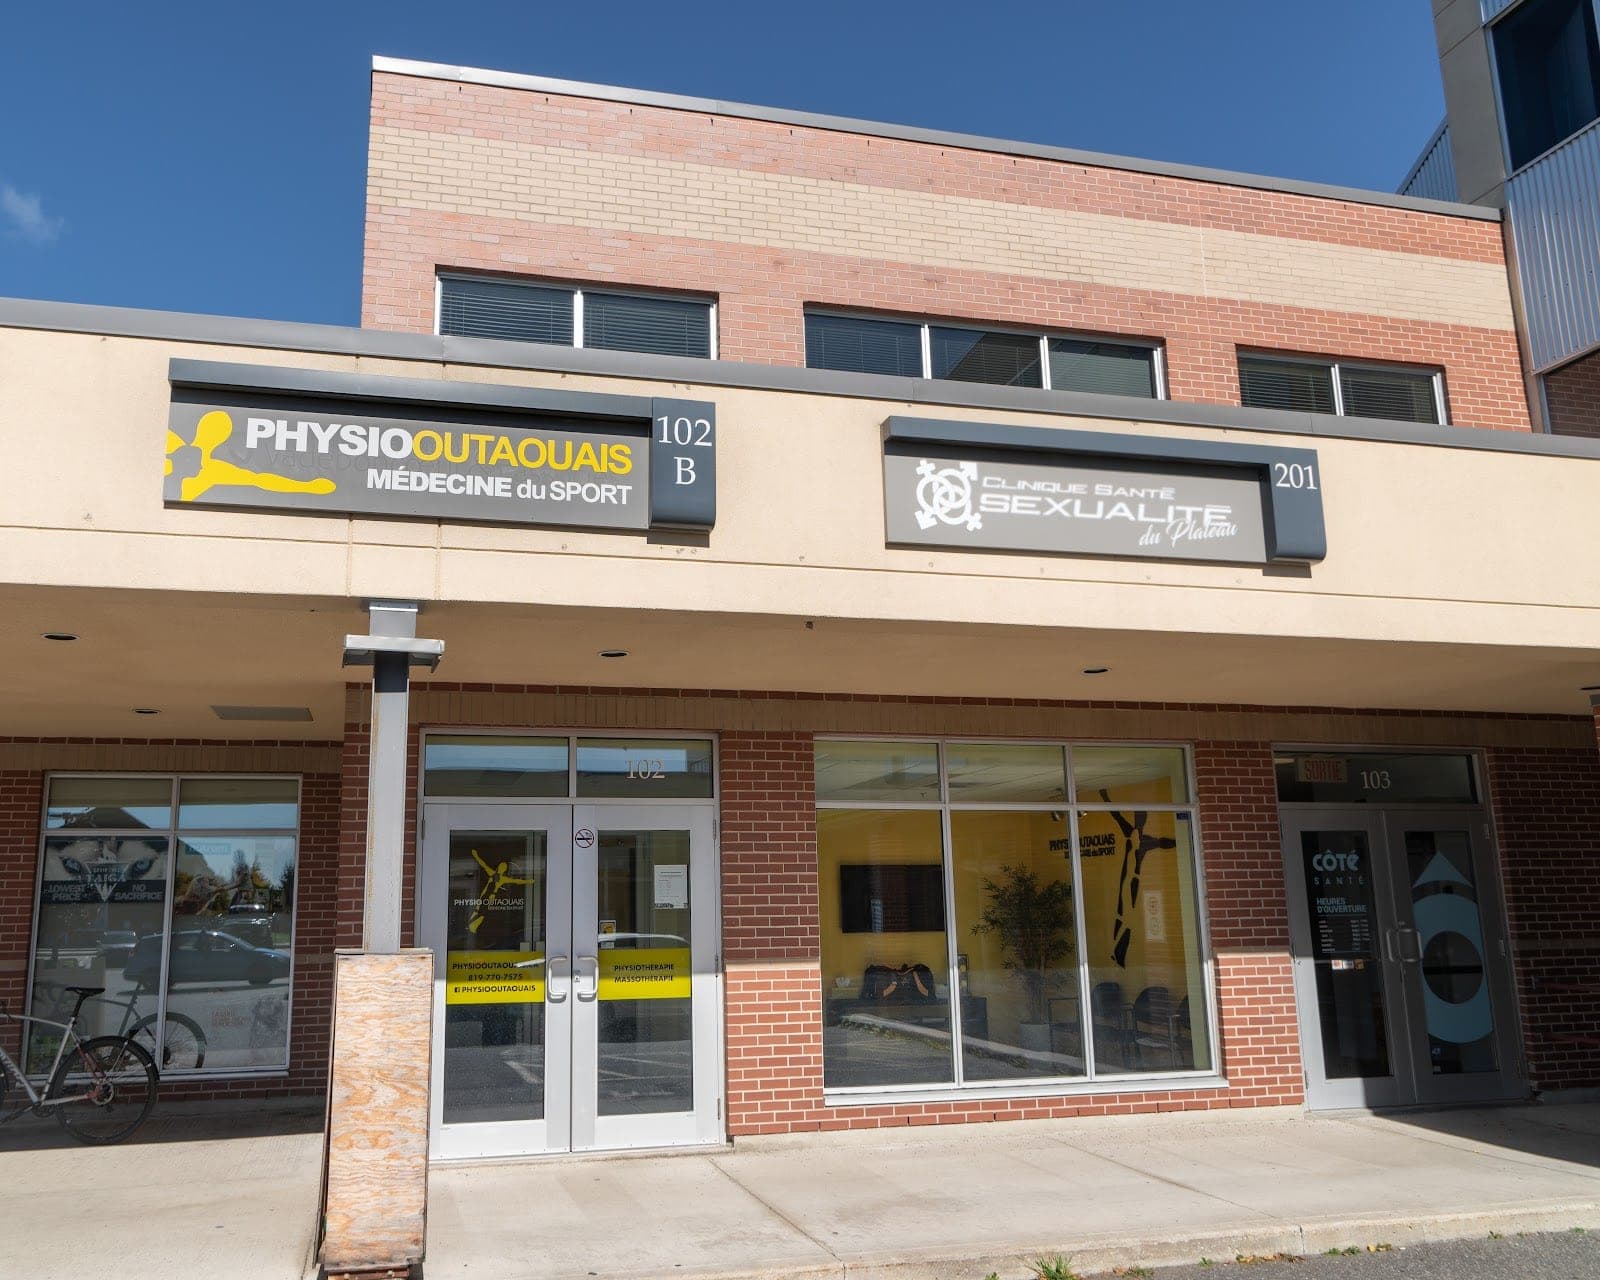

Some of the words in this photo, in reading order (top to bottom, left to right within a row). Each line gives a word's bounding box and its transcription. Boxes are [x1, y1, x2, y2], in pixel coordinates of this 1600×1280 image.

[657, 415, 713, 447] 102
[246, 417, 633, 475] PHYSIOOUTAOUAIS
[673, 456, 697, 485] B
[1274, 462, 1318, 490] 201
[367, 465, 512, 498] MÉDECINE
[517, 479, 546, 501] du
[549, 481, 633, 505] SPORT
[979, 492, 1233, 529] SEXUALITÉ
[1138, 523, 1162, 546] du
[1165, 517, 1239, 548] Plateau
[625, 758, 666, 780] 102
[1304, 759, 1343, 781] SORTIE
[1360, 770, 1391, 790] 103
[115, 892, 163, 901] SACRIFICE
[132, 884, 146, 892] NO
[1316, 897, 1346, 905] HEURES
[1317, 904, 1367, 913] D'OUVERTURE
[462, 984, 536, 993] PHYSIOOUTAOUAIS
[468, 973, 523, 982] 819-770-7575
